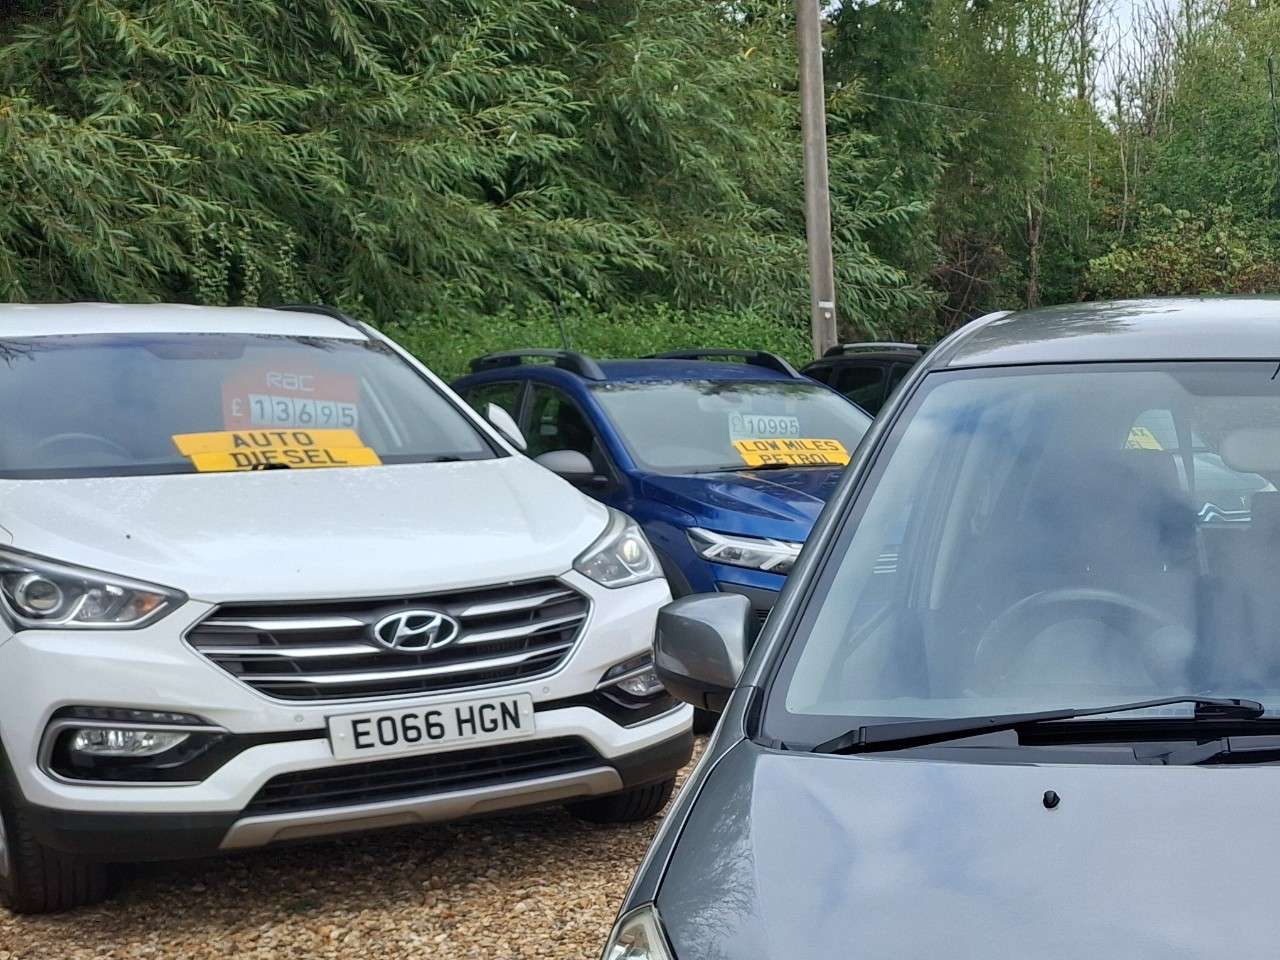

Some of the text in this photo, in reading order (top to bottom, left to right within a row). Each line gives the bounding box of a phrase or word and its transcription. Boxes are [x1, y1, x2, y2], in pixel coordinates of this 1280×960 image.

[233, 432, 314, 448] AUTO
[740, 440, 840, 452] LOW MILES
[230, 449, 348, 468] DIESEL
[455, 700, 522, 737] HGN
